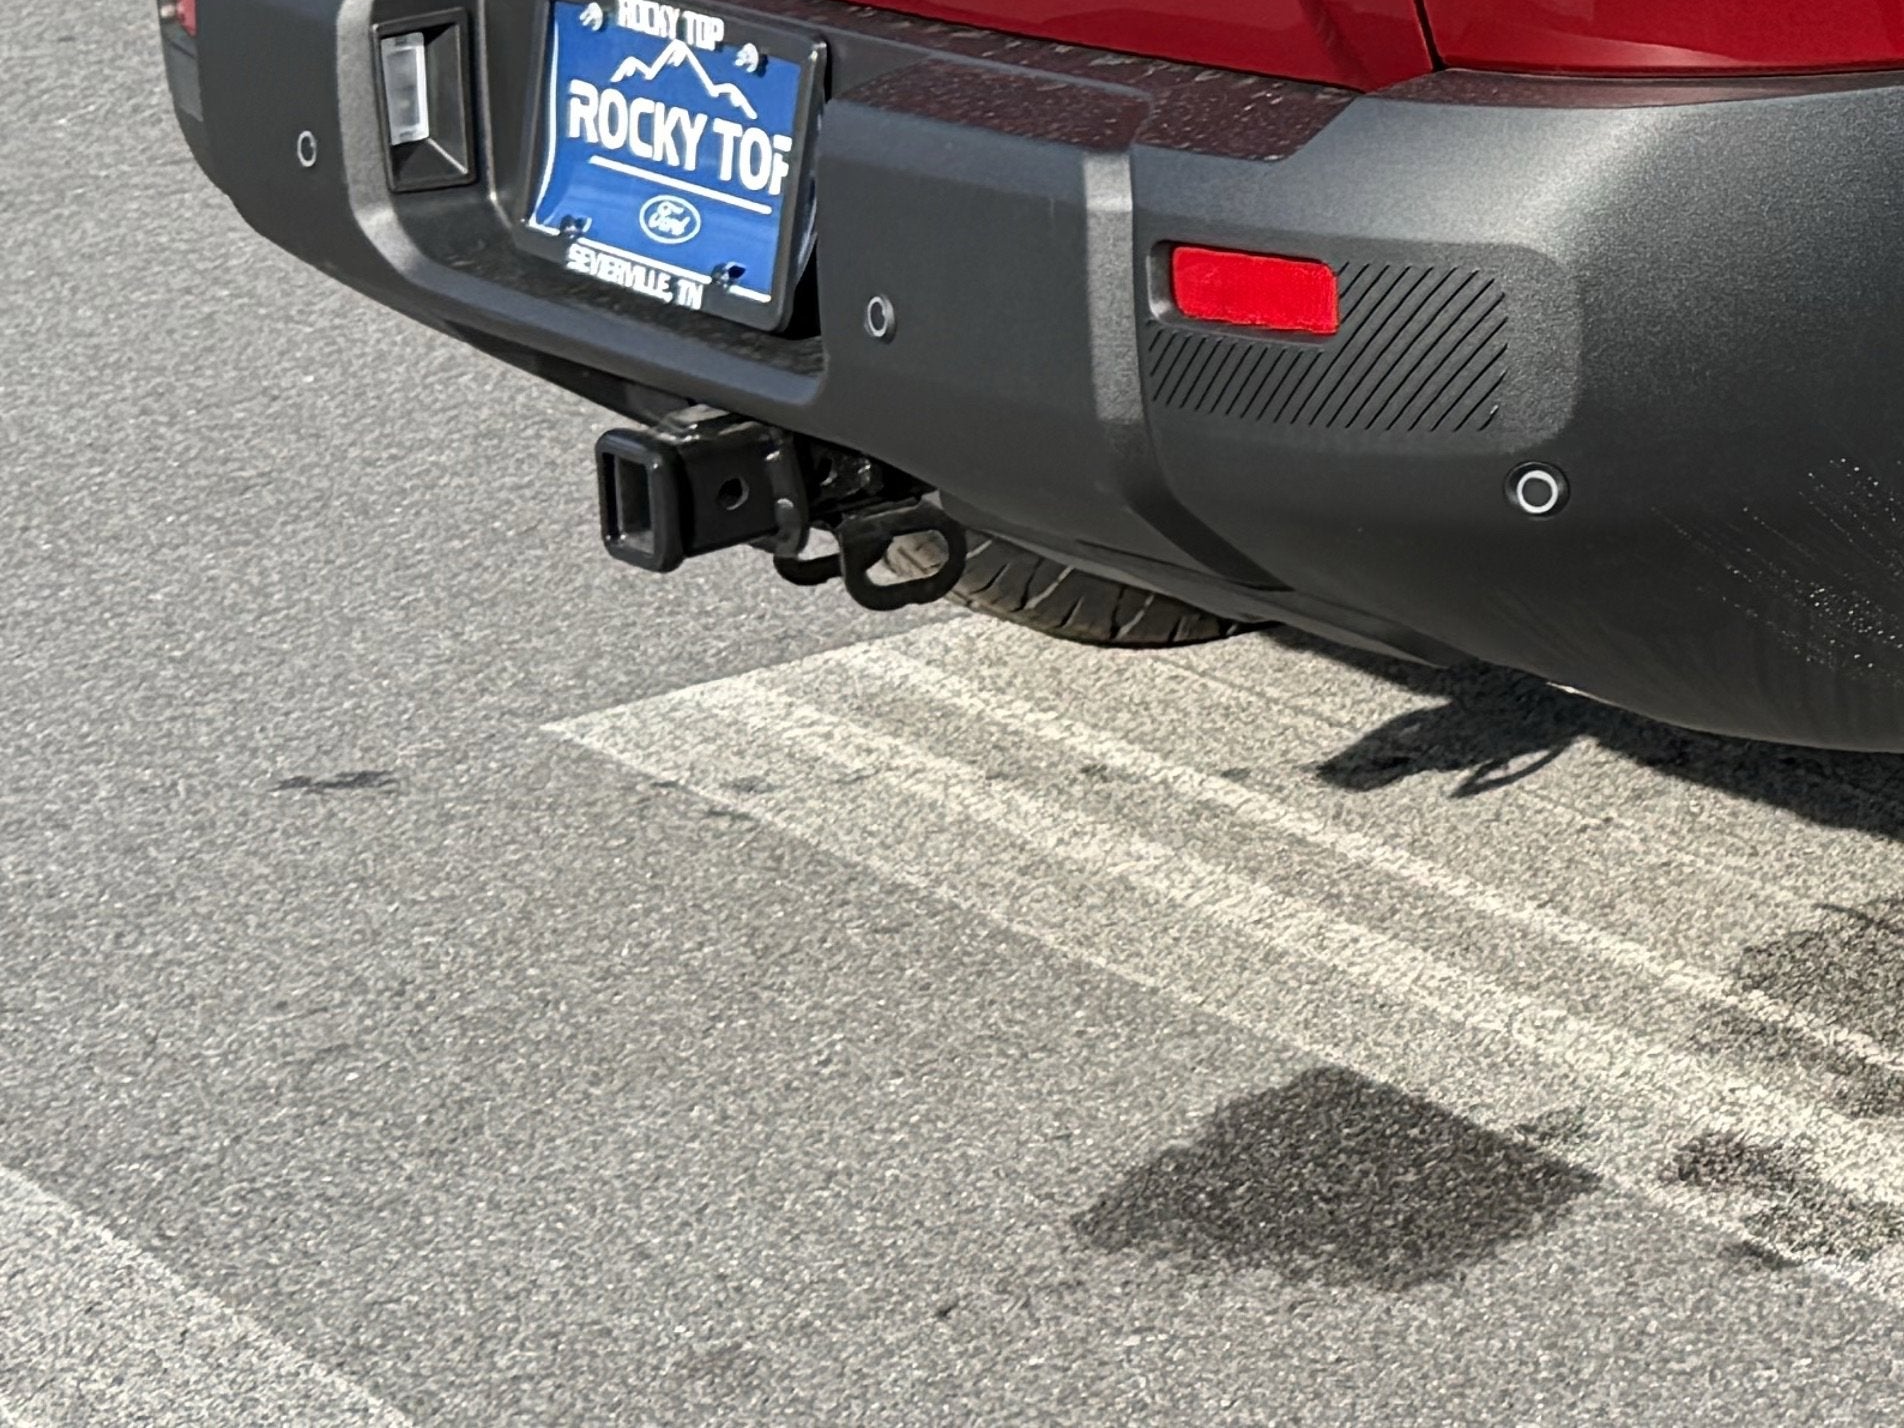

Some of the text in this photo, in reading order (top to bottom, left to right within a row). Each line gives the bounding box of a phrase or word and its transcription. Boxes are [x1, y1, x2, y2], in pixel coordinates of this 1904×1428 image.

[682, 10, 725, 52] TOP
[568, 78, 709, 172] ROCKY
[648, 200, 691, 237] Ford
[565, 242, 705, 311] SEVIERVILLE, TN
